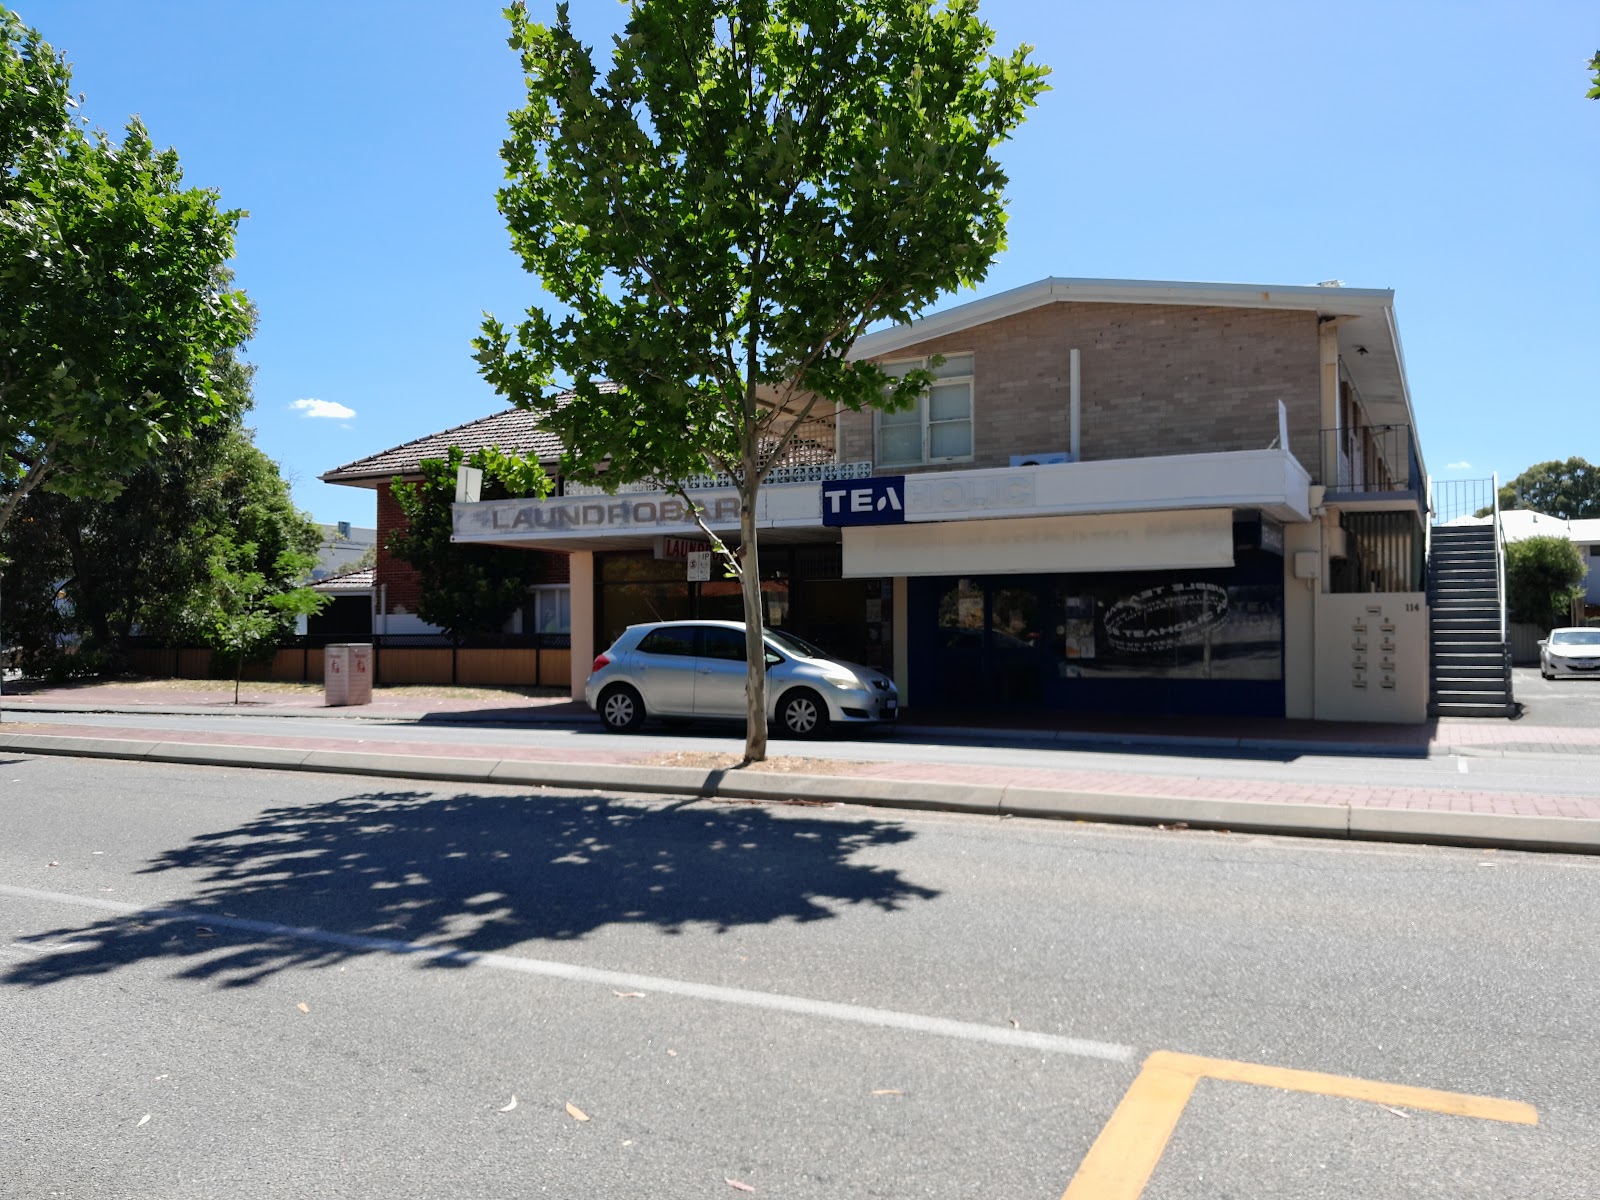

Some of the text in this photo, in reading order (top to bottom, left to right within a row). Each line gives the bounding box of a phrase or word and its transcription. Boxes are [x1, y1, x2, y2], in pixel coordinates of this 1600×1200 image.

[492, 497, 741, 530] LAUNDROBAR
[824, 486, 903, 514] TEA
[1405, 603, 1420, 612] 114
